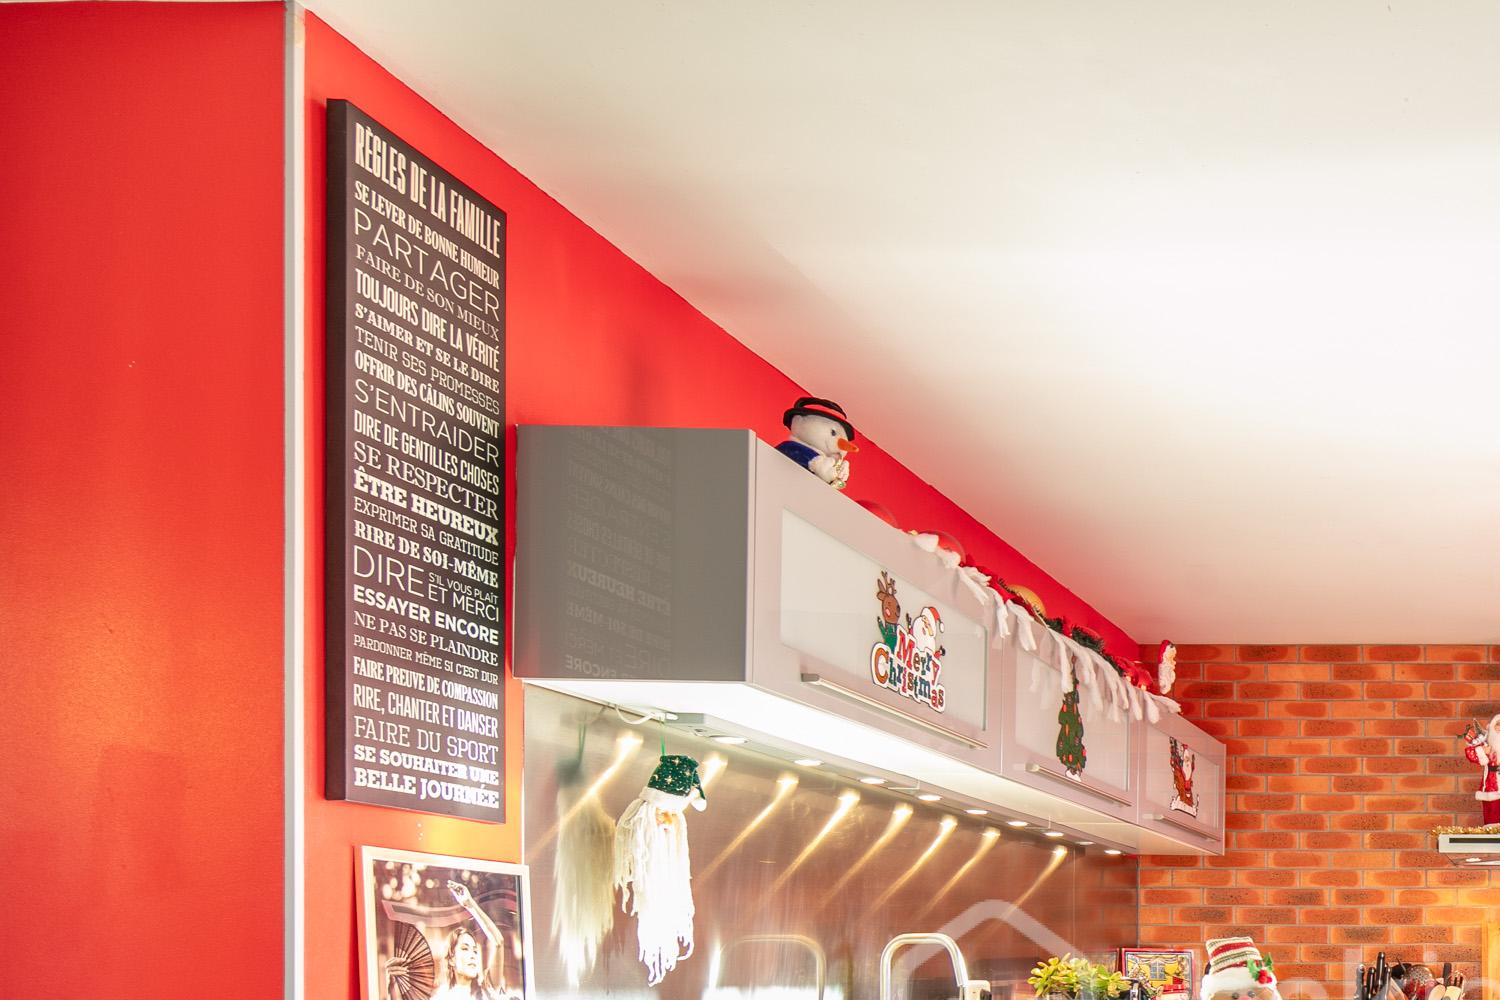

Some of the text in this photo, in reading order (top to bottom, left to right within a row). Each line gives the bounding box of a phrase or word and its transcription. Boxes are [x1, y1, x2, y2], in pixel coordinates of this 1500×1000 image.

[355, 123, 500, 258] RÈGLES DE LA FAMILLE
[354, 180, 499, 289] SE LEVER DE BONNE HUMEUR
[354, 208, 499, 321] PARTAGER
[355, 243, 499, 342] FAIRE DE SON MIEUX
[355, 268, 500, 372] TOUJOURS DIRE LA VÉRITÉ
[354, 325, 500, 415] TENIR SES PROMESSES
[355, 303, 499, 394] S'AIMER ET SE LE DIRE
[354, 349, 499, 438] OFFRIR DES CÂLINS SOUVENT
[354, 378, 498, 465] S'ENTRAIDER
[353, 409, 499, 495] DIRE DE GENTILLES CHOSES
[353, 440, 497, 520] SE RESPECTER
[353, 465, 498, 545] ÊTRE HEUREUX
[353, 496, 499, 566] EXPRIMER SA GRATITUDE
[353, 545, 424, 597] DIRE
[354, 519, 498, 588] RIRE DE SOI-MÊME
[428, 571, 498, 605] S'IL VOUS PLAÎT
[353, 584, 499, 645] ESSAYER ENCORE
[428, 583, 499, 622] ET MERCI
[353, 610, 498, 667] NE PAS SE PLAINDRE
[353, 634, 499, 685] PARDONNER MÊME SI C'EST DUR
[896, 630, 940, 686] Merry
[353, 655, 498, 709] FAIRE PREUVE DE COMPASSION
[353, 683, 498, 738] RIRE, CHANTER ET DANSER
[874, 647, 944, 708] Christmas
[353, 715, 499, 765] FAIRE DU SPORT
[353, 744, 499, 786] SE SOUHAITER UNE
[354, 767, 499, 809] BELLE JOURNÉE
